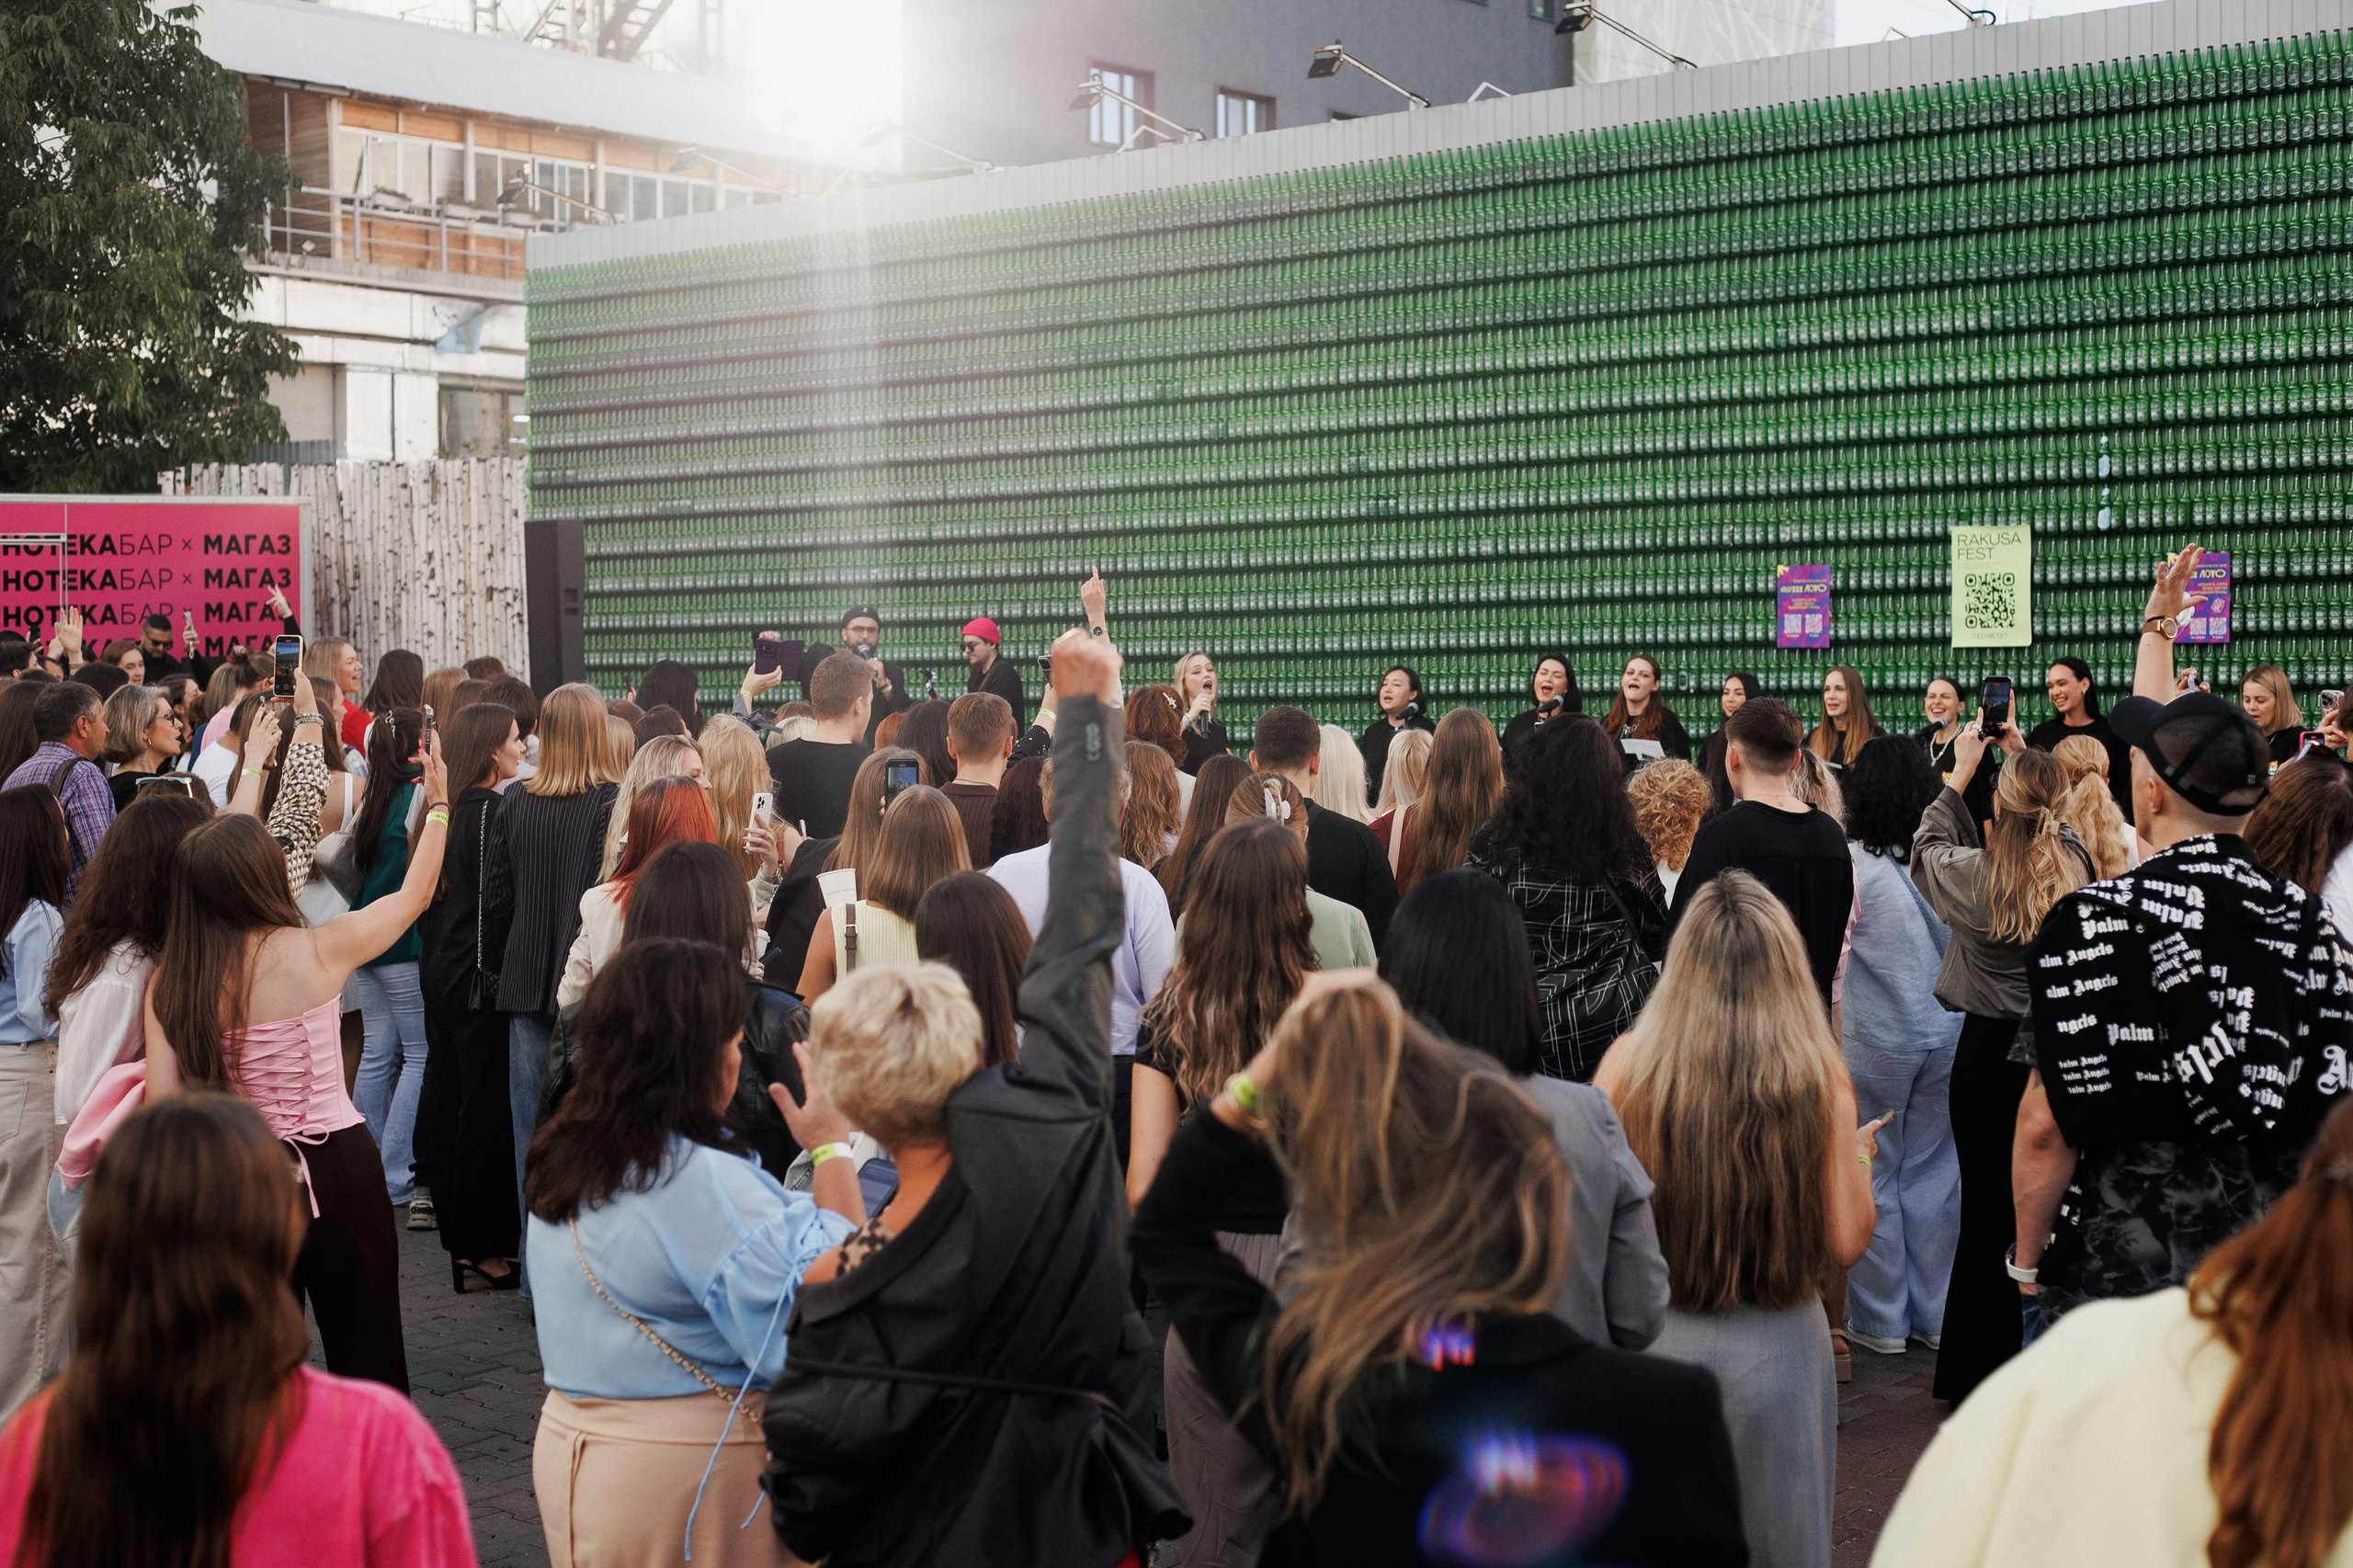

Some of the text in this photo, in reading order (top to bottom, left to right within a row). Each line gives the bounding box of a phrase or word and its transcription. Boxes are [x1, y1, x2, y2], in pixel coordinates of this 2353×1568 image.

[203, 534, 291, 555] МАГАЗ
[1957, 532, 2022, 546] RAKUSA
[1957, 547, 1995, 560] FEST
[204, 568, 291, 589] МАГАЗ
[2200, 569, 2226, 578] ЛОТО
[2081, 916, 2130, 940] Palm
[2066, 943, 2114, 966] Angels
[2074, 974, 2119, 996] Angels
[2108, 1023, 2155, 1046] Palm
